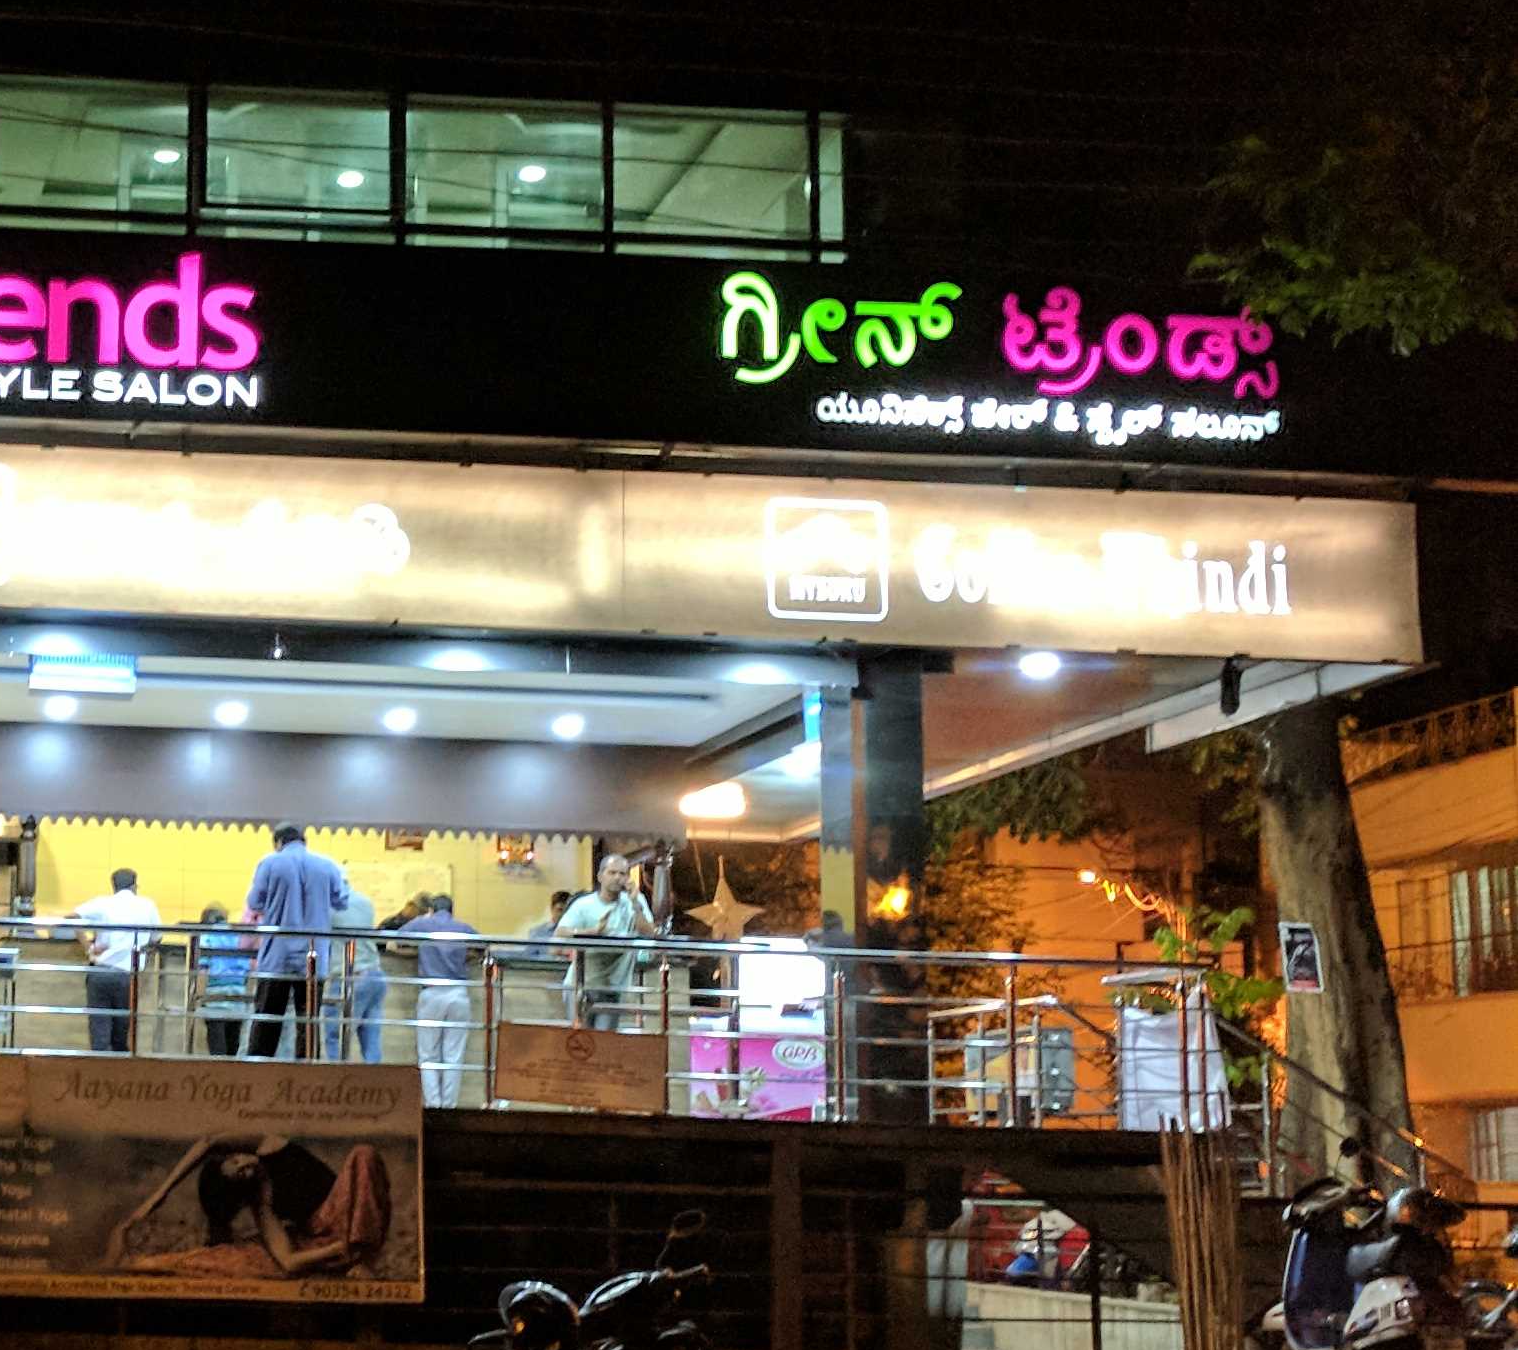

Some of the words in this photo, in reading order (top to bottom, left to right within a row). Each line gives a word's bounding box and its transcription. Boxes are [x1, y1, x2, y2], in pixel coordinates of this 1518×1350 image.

[720, 272, 962, 384] ಗ್ರೀನ್
[91, 369, 259, 409] SALON
[1100, 530, 1292, 617] indi
[55, 1071, 170, 1109] Aayana
[182, 1072, 251, 1112] Yoga
[266, 1074, 402, 1114] Academy
